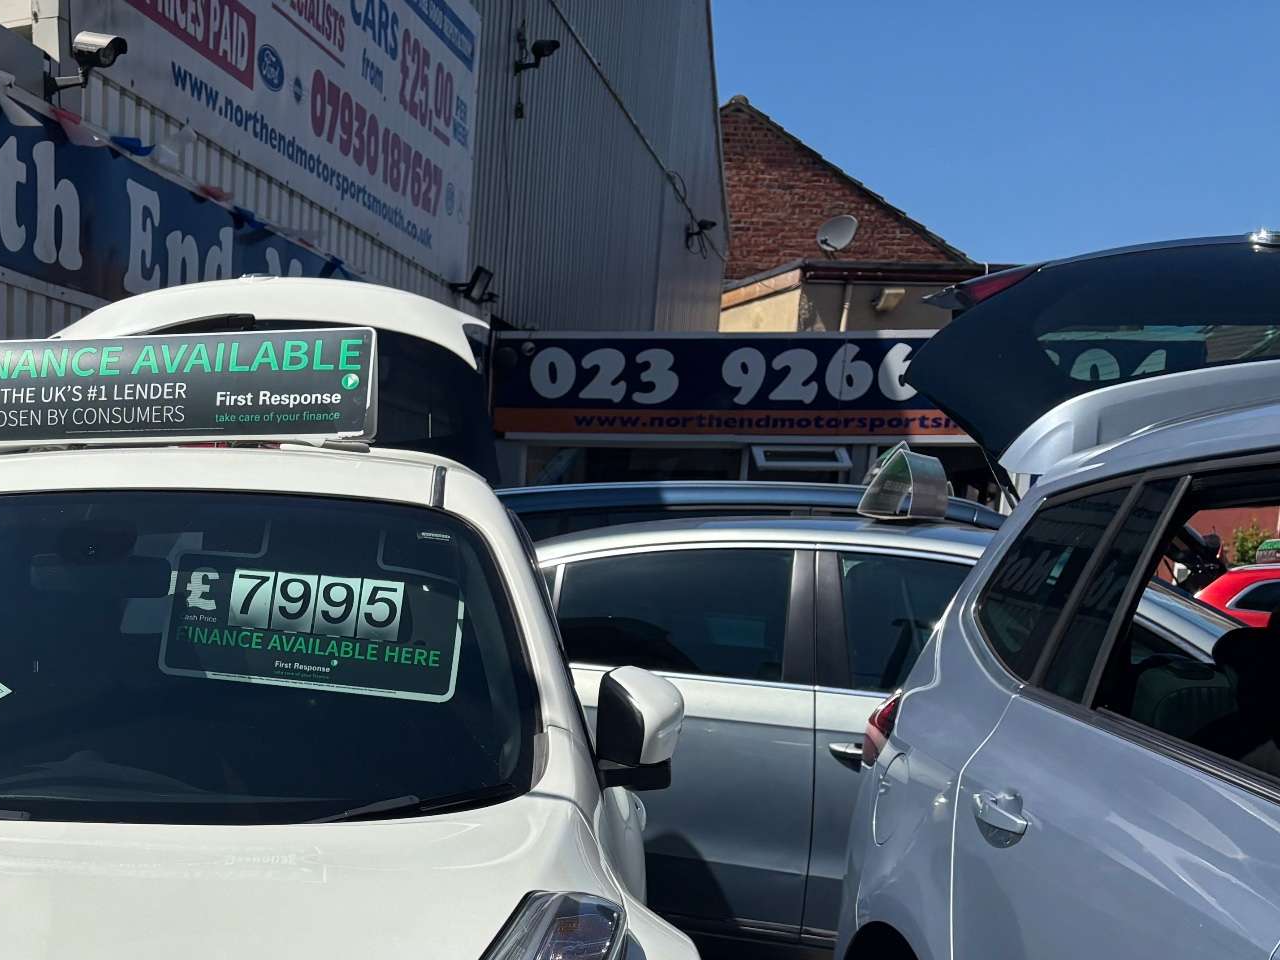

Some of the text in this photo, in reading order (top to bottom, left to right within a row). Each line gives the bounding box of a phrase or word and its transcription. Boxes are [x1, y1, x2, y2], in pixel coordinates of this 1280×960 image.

[145, 0, 248, 71] CES PAID
[291, 0, 345, 52] IALISTS
[361, 47, 384, 94] from
[171, 60, 432, 252] www.northendmotorsportsmouth.co.uk
[311, 69, 442, 217] 07930 187627
[123, 177, 233, 295] End
[131, 339, 363, 375] AVAILABLE
[529, 346, 680, 404] 023
[0, 387, 36, 404] THE
[87, 385, 107, 401] #1
[113, 382, 187, 401] LENDER
[48, 408, 69, 426] BY
[72, 405, 185, 425] CONSUMERS
[216, 390, 341, 409] First Response
[216, 411, 341, 424] take care of your finance
[237, 574, 398, 628] 7995
[267, 635, 379, 662] AVAILABLE
[384, 645, 441, 667] HERE
[275, 660, 331, 673] First Response
